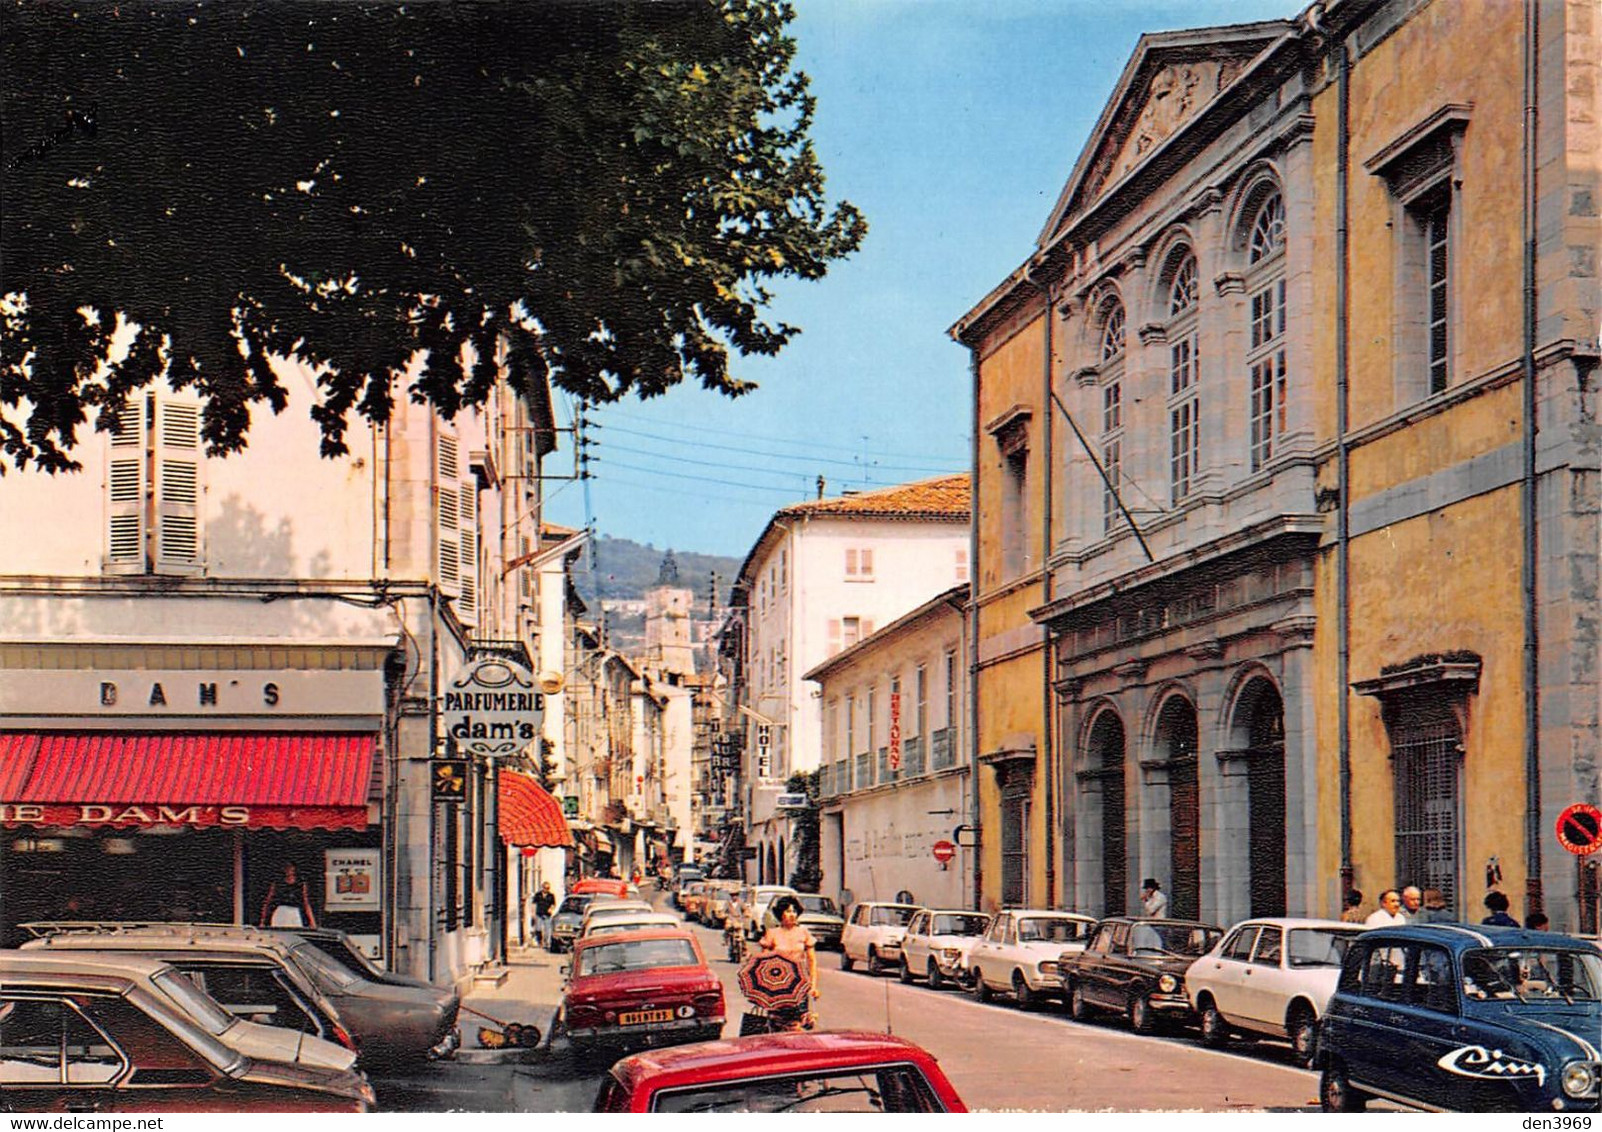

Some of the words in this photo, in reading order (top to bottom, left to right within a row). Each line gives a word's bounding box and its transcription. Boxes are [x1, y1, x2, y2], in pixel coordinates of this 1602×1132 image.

[445, 692, 545, 711] PARFUMERIE
[452, 715, 534, 739] dam's
[890, 694, 900, 770] RESTAURANT
[759, 725, 769, 777] HOTEL
[79, 806, 250, 824] DAM'S
